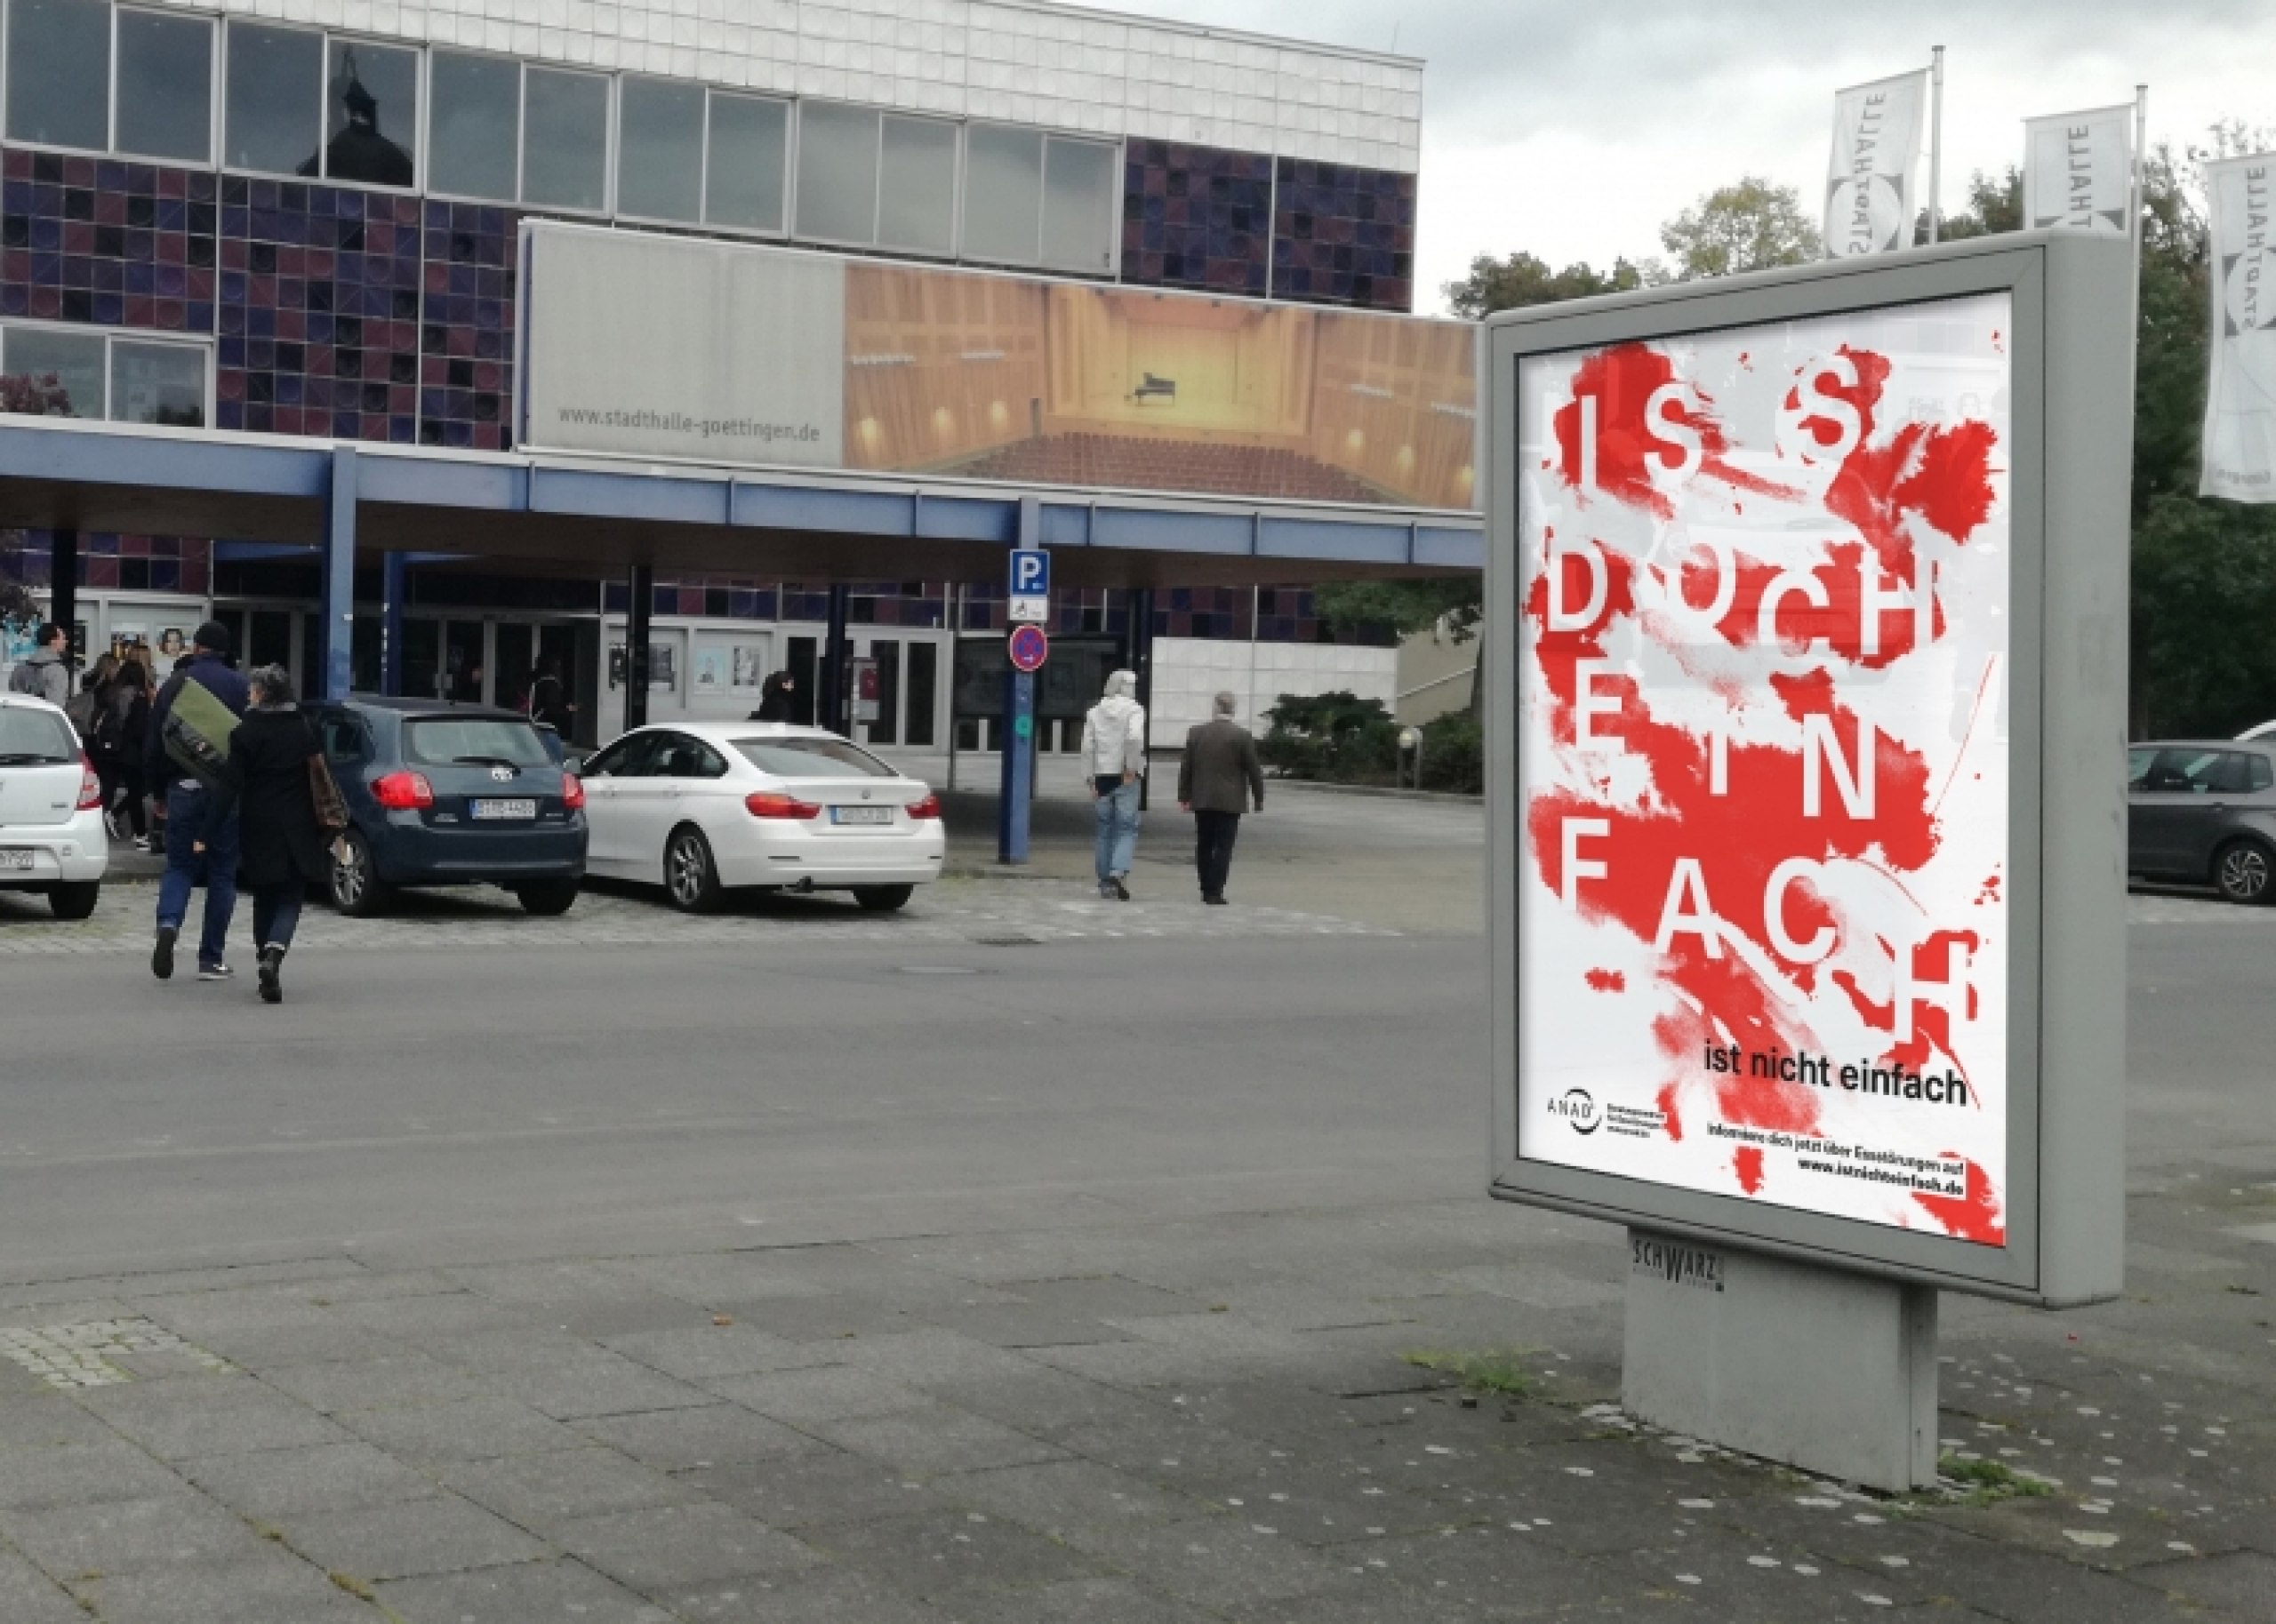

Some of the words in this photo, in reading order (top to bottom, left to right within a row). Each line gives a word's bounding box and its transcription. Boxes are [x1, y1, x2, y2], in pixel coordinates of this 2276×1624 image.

[557, 406, 820, 443] www.stadthalle-goettingen.de
[1018, 556, 1042, 589] P
[1703, 1037, 1742, 1076] ist
[1751, 1047, 1831, 1087] nicht
[1839, 1058, 1967, 1108] einfach
